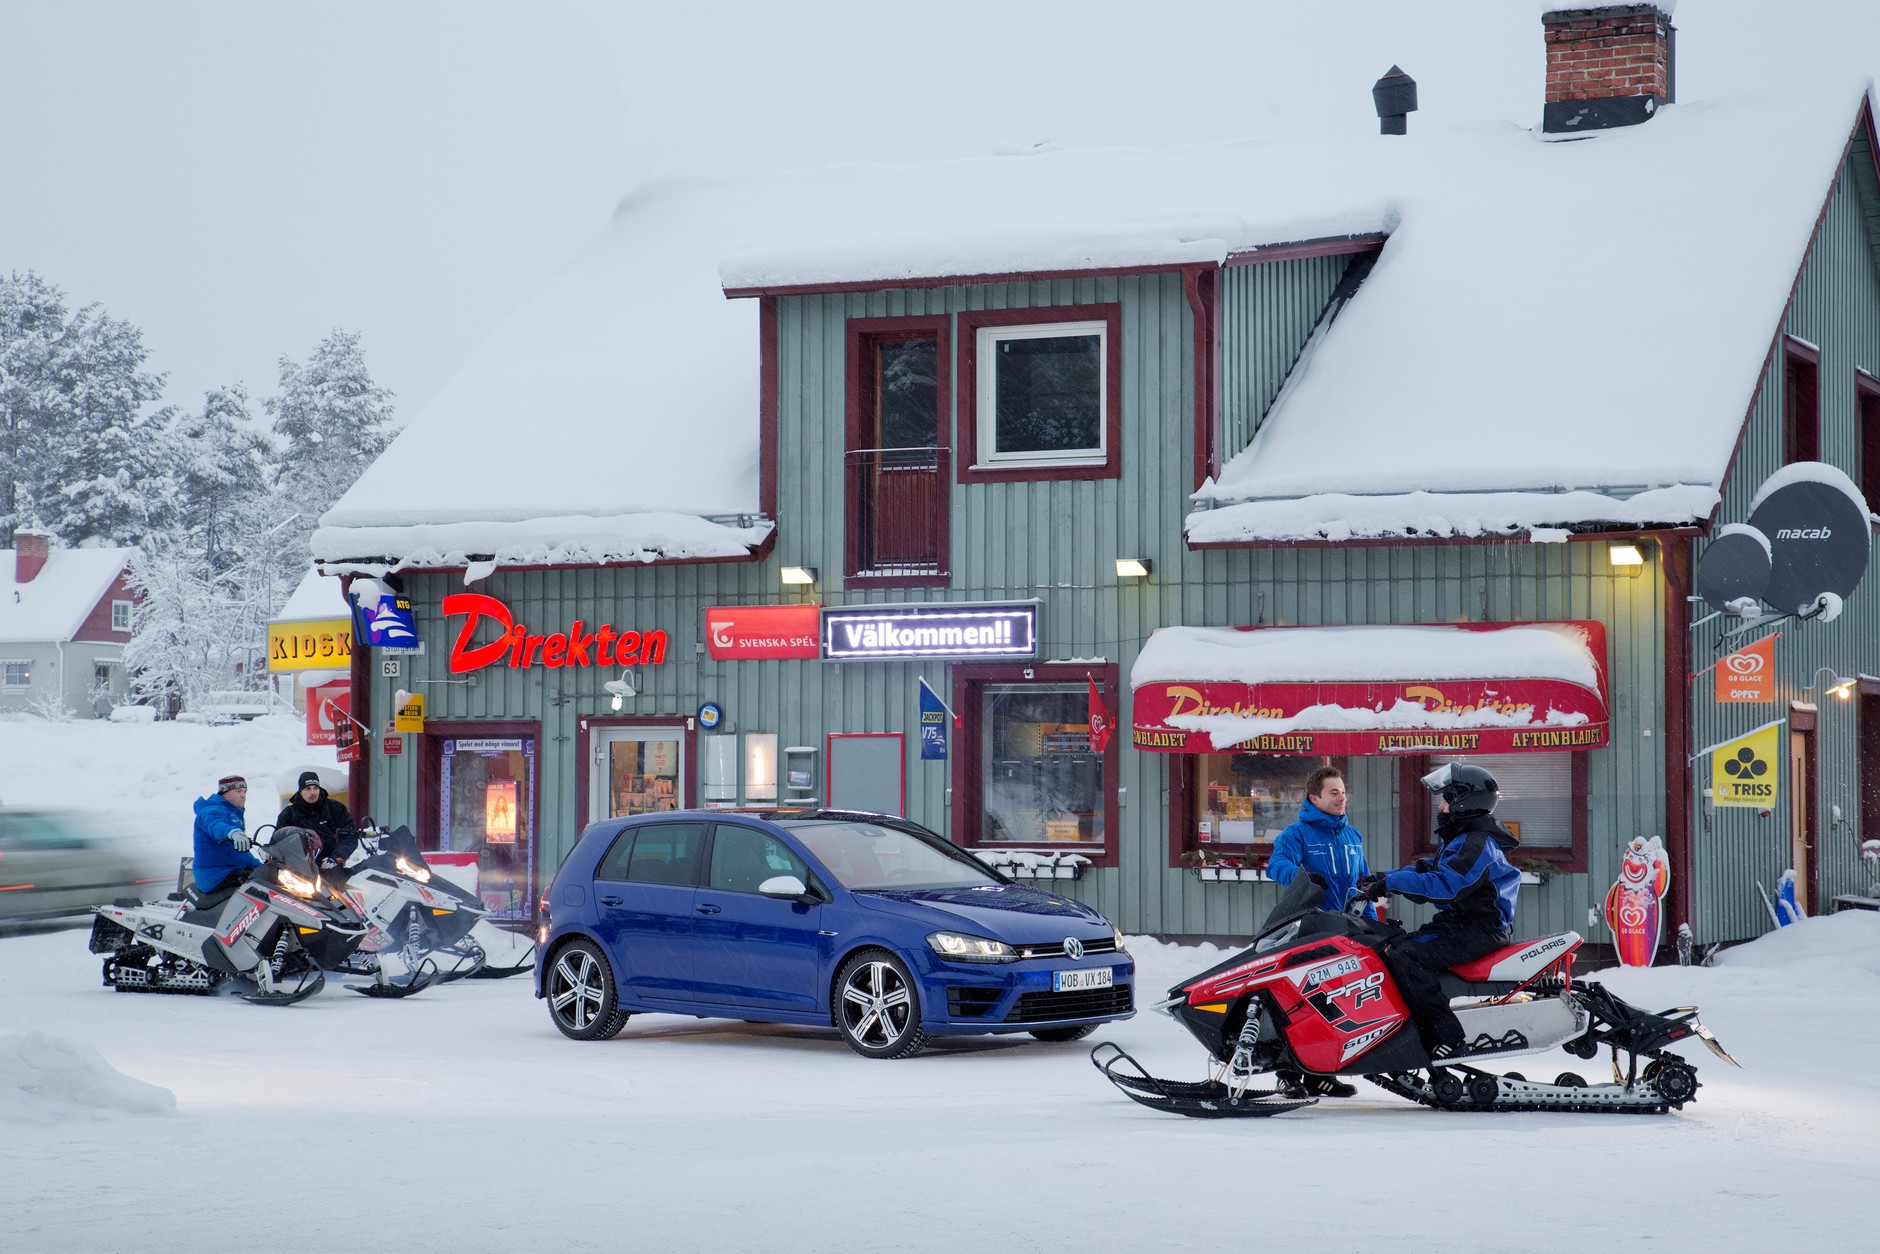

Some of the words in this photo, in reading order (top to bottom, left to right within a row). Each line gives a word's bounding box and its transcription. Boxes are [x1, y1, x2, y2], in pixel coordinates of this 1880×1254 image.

[1776, 526, 1832, 540] macab
[396, 600, 411, 609] ATG
[442, 593, 668, 674] Direkten
[739, 638, 787, 648] SVENSKA
[789, 637, 816, 647] SPEL
[845, 620, 1011, 648] Välkommen!!
[272, 632, 351, 660] KIOSK
[384, 662, 398, 674] 63
[1730, 689, 1761, 699] ÖPPET
[923, 713, 943, 722] JACKPOT
[921, 726, 937, 740] V75
[1379, 734, 1479, 750] AFTONBLADET
[1512, 728, 1601, 748] AFTONBLADET
[458, 741, 473, 749] Spelet
[1732, 783, 1772, 796] TRISS
[272, 893, 317, 917] POLARIS
[1520, 938, 1567, 963] POLARIS
[1061, 973, 1079, 988] WOB
[1085, 972, 1096, 987] VX
[1097, 970, 1112, 985] 184
[1202, 955, 1278, 986] POLARIS
[1309, 968, 1332, 984] PZM
[1337, 959, 1359, 975] 948
[1326, 971, 1385, 1005] PRO
[1342, 1028, 1384, 1050] 600
